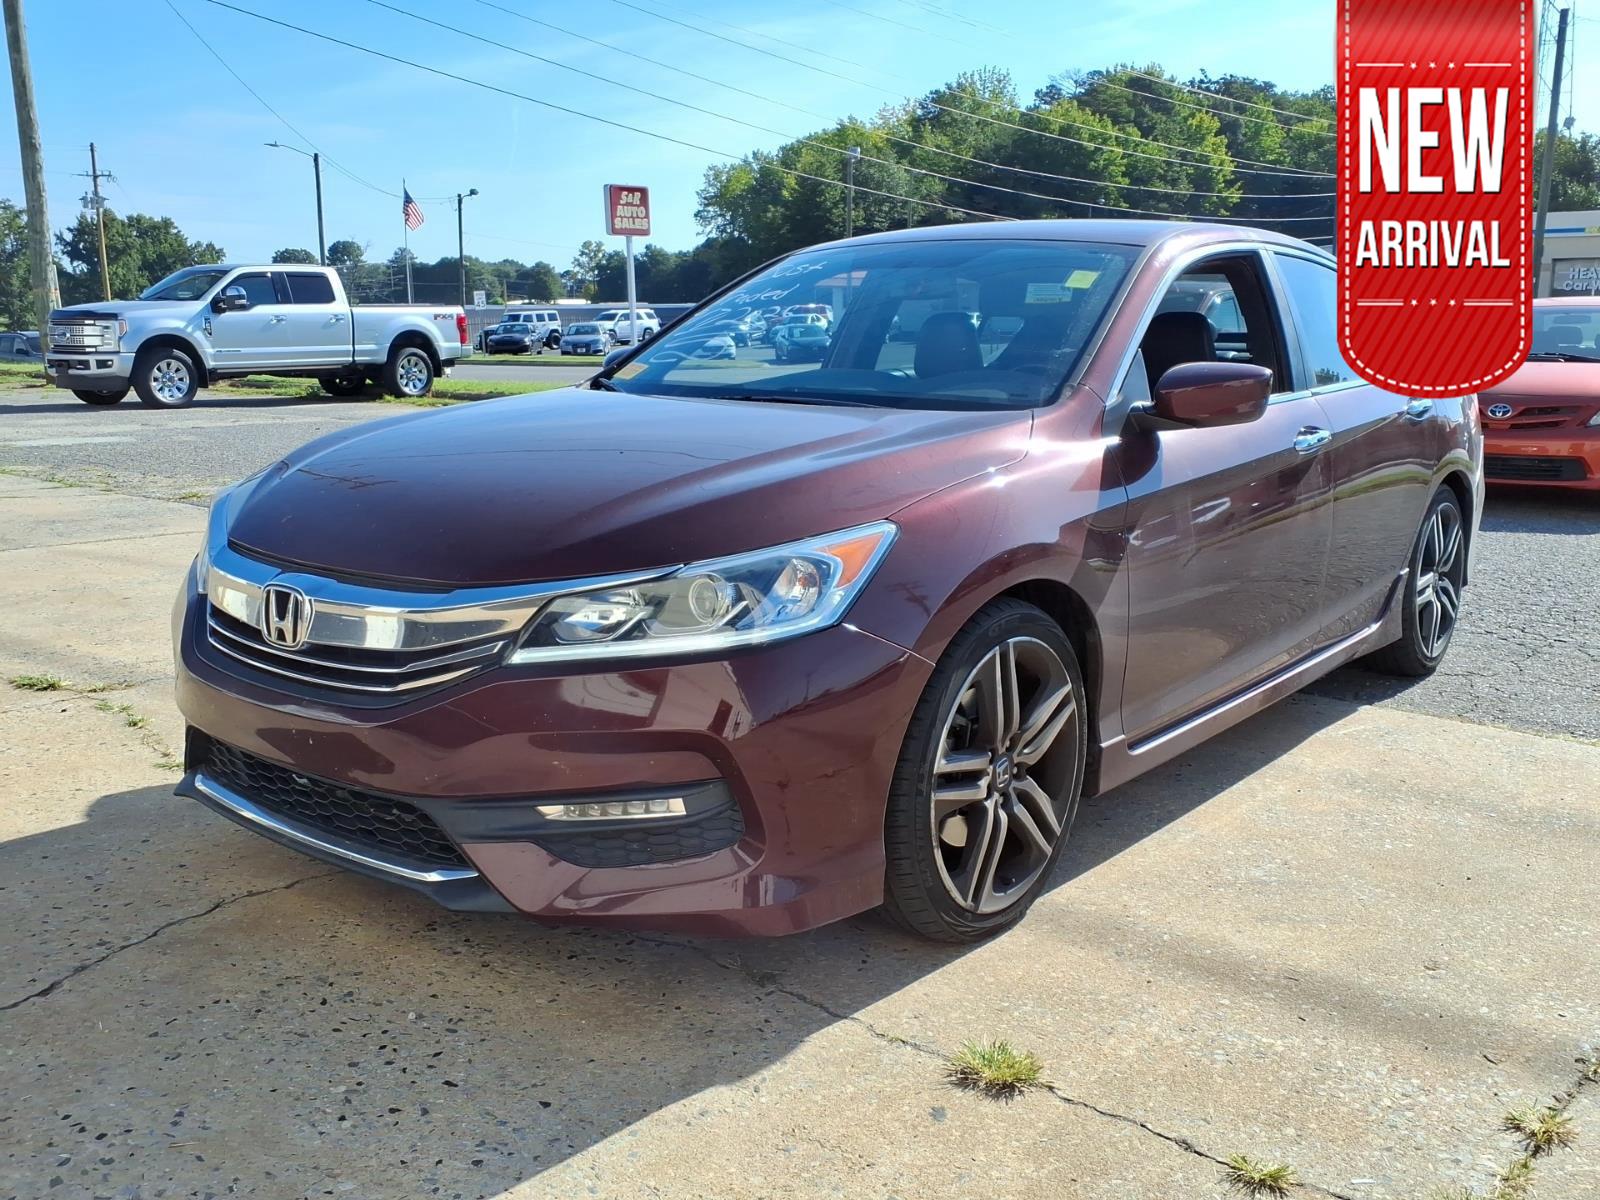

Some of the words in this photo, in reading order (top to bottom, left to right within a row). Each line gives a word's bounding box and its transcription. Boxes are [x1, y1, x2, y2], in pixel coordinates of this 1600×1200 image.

[616, 205, 646, 218] AUTO
[614, 217, 649, 230] SALES
[1569, 267, 1600, 280] HEA
[1563, 280, 1589, 291] Car
[476, 300, 486, 308] 45
